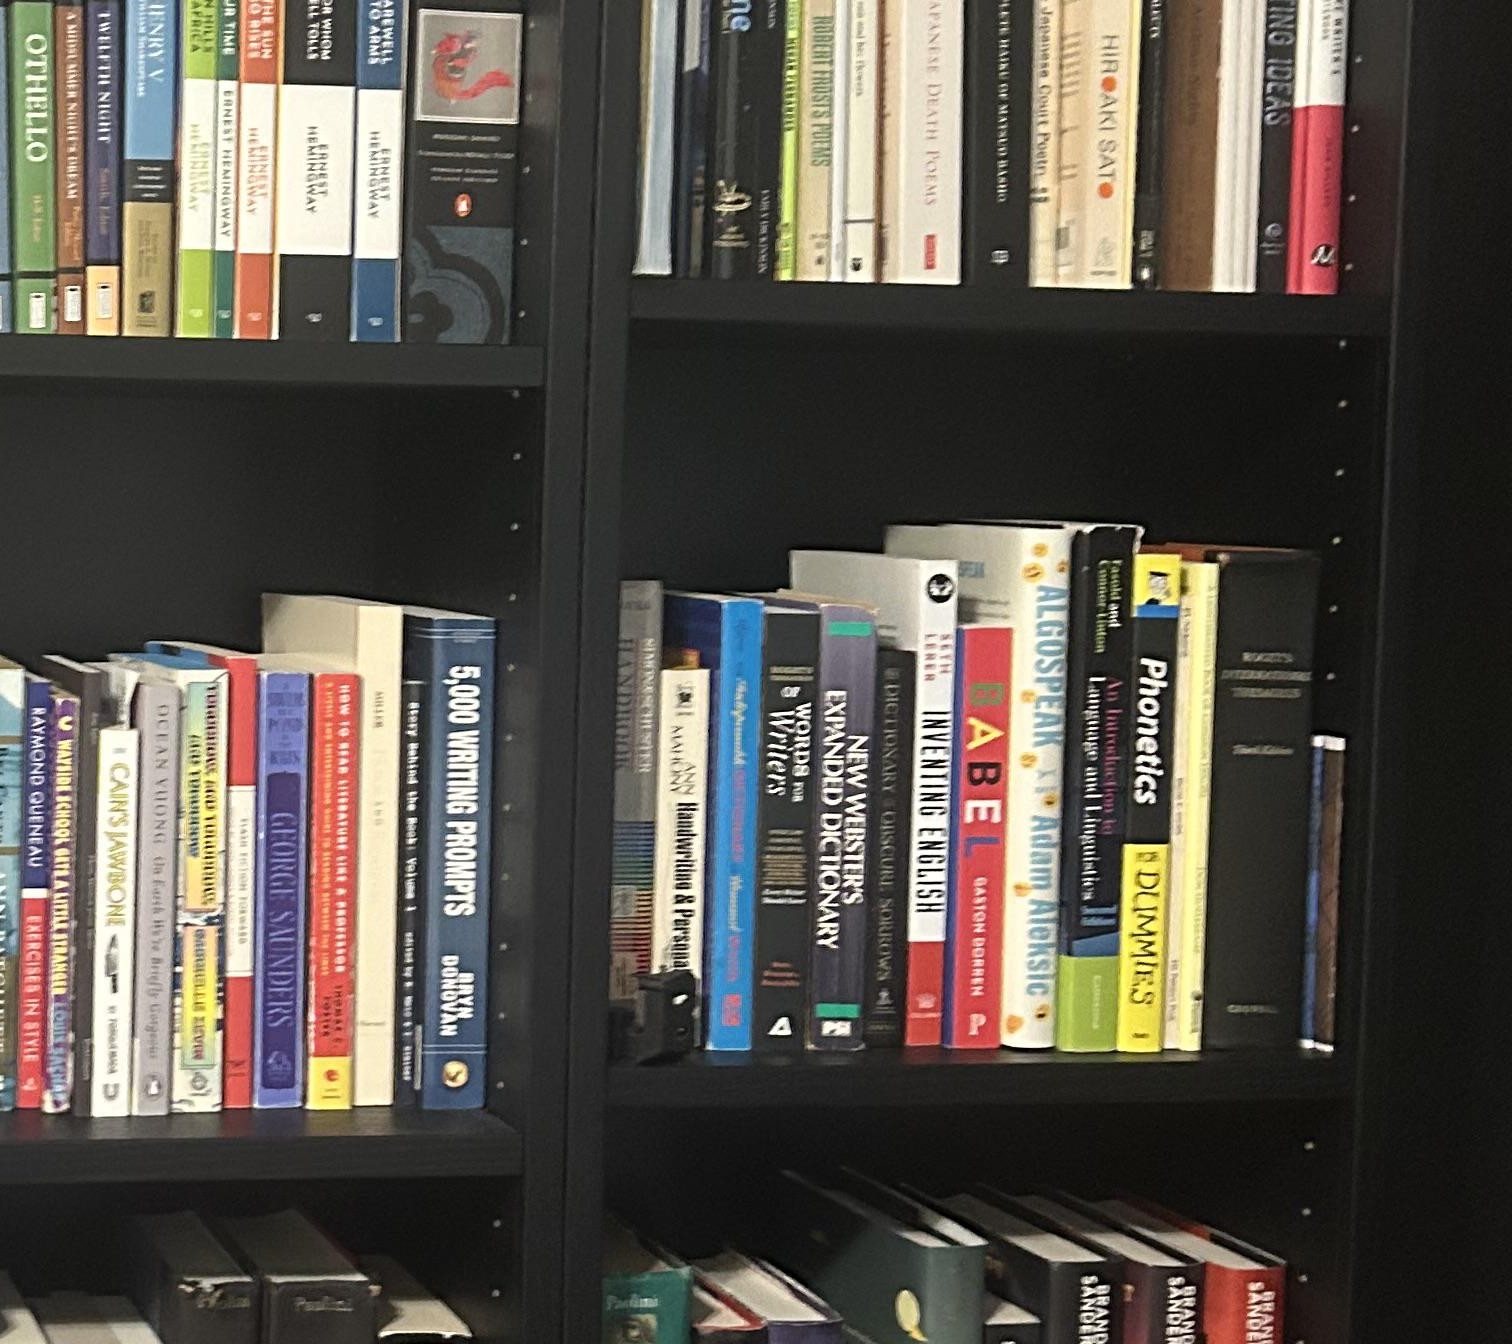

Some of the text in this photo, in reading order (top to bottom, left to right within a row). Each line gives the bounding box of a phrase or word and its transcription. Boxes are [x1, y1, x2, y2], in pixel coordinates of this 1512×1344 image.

[25, 33, 47, 162] OTHELLO
[97, 11, 110, 143] TWELFTH NIGHT
[306, 24, 318, 60] TOLLS
[320, 19, 332, 60] WHOM
[1266, 58, 1293, 127] IDEAS
[220, 90, 233, 237] ERNEST HEMINGWAY
[28, 707, 46, 866] RAYMOND QUENEAU
[443, 666, 479, 915] 5,000 WRITING PROMPTS
[1027, 586, 1067, 996] ALGOSPEAK Adam Aleksic
[1135, 658, 1167, 804] Phonetics
[105, 763, 129, 927] CAIN'S JAWBONE
[817, 690, 845, 948] EXPANDED DICTIONARY
[843, 736, 868, 904] NEW WEBSTER'S
[916, 711, 950, 913] INVENTING ENGLISH
